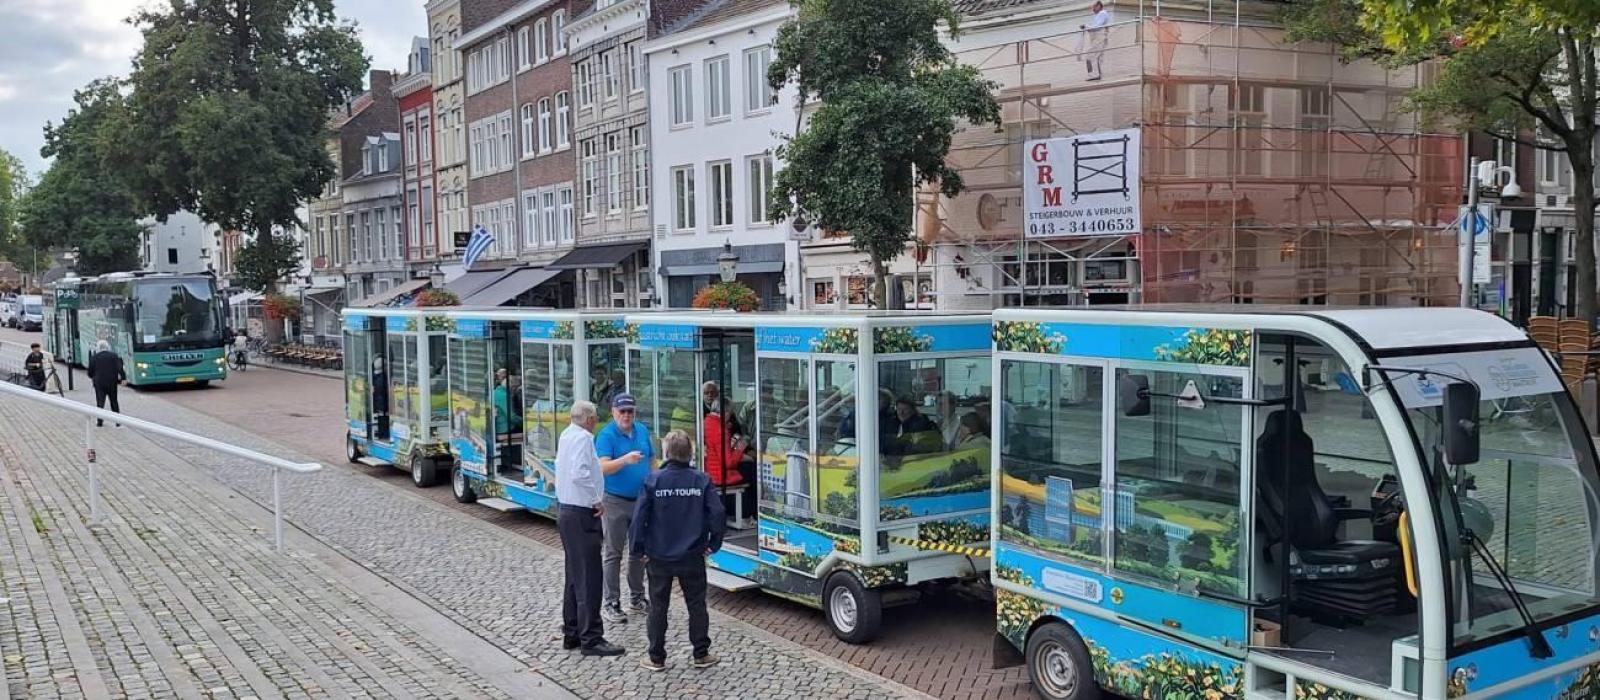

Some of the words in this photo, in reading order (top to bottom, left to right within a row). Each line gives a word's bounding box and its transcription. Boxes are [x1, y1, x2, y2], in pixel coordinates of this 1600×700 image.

[1032, 143, 1062, 207] GRM
[1029, 210, 1084, 220] STEIGERBOUW
[1086, 209, 1092, 217] &
[1094, 206, 1133, 216] VERHUUR
[1030, 222, 1055, 235] 043
[1069, 218, 1134, 233] 3440653
[655, 488, 701, 497] CITY-TOURS
